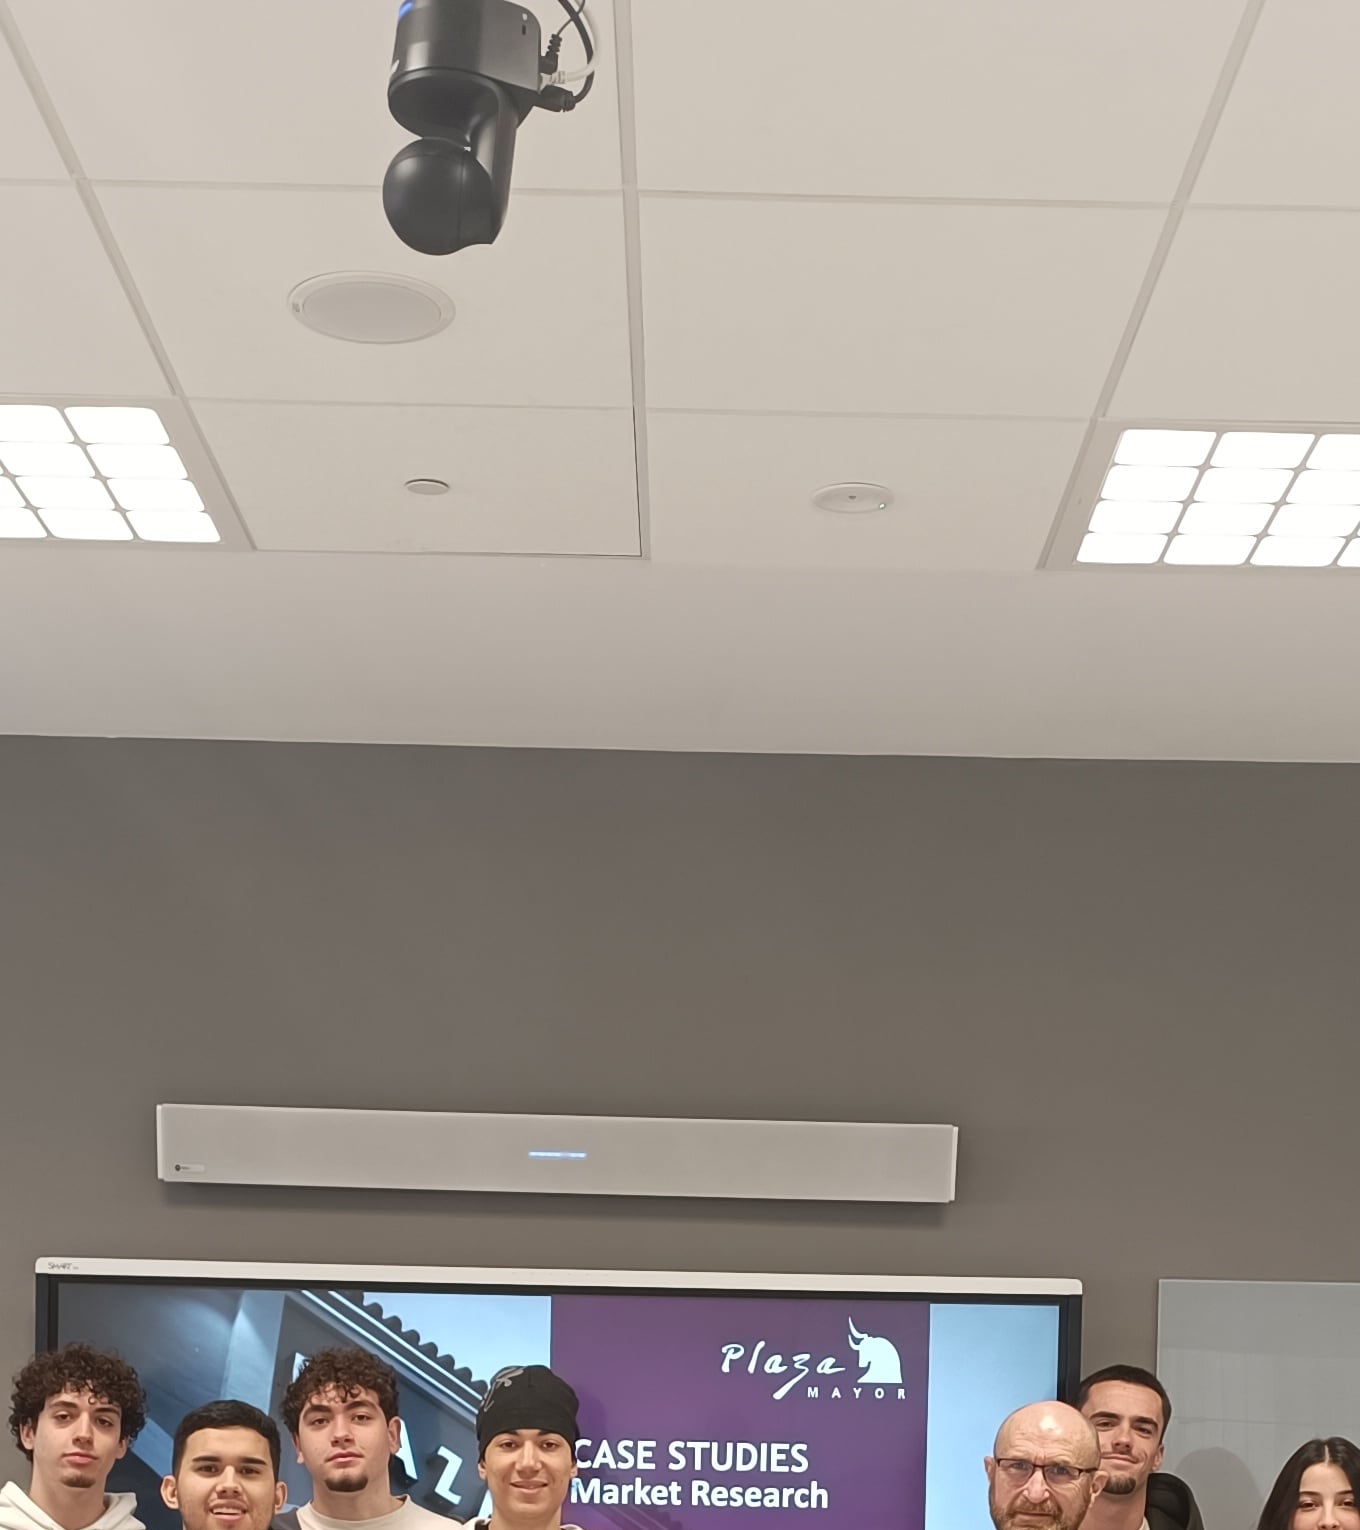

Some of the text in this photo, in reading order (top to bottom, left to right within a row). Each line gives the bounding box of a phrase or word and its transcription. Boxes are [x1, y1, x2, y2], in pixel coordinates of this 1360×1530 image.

[721, 1340, 846, 1400] Plaza
[807, 1386, 906, 1400] MAYOR
[574, 1439, 809, 1473] CASE STUDIES
[570, 1477, 829, 1509] Market Research
